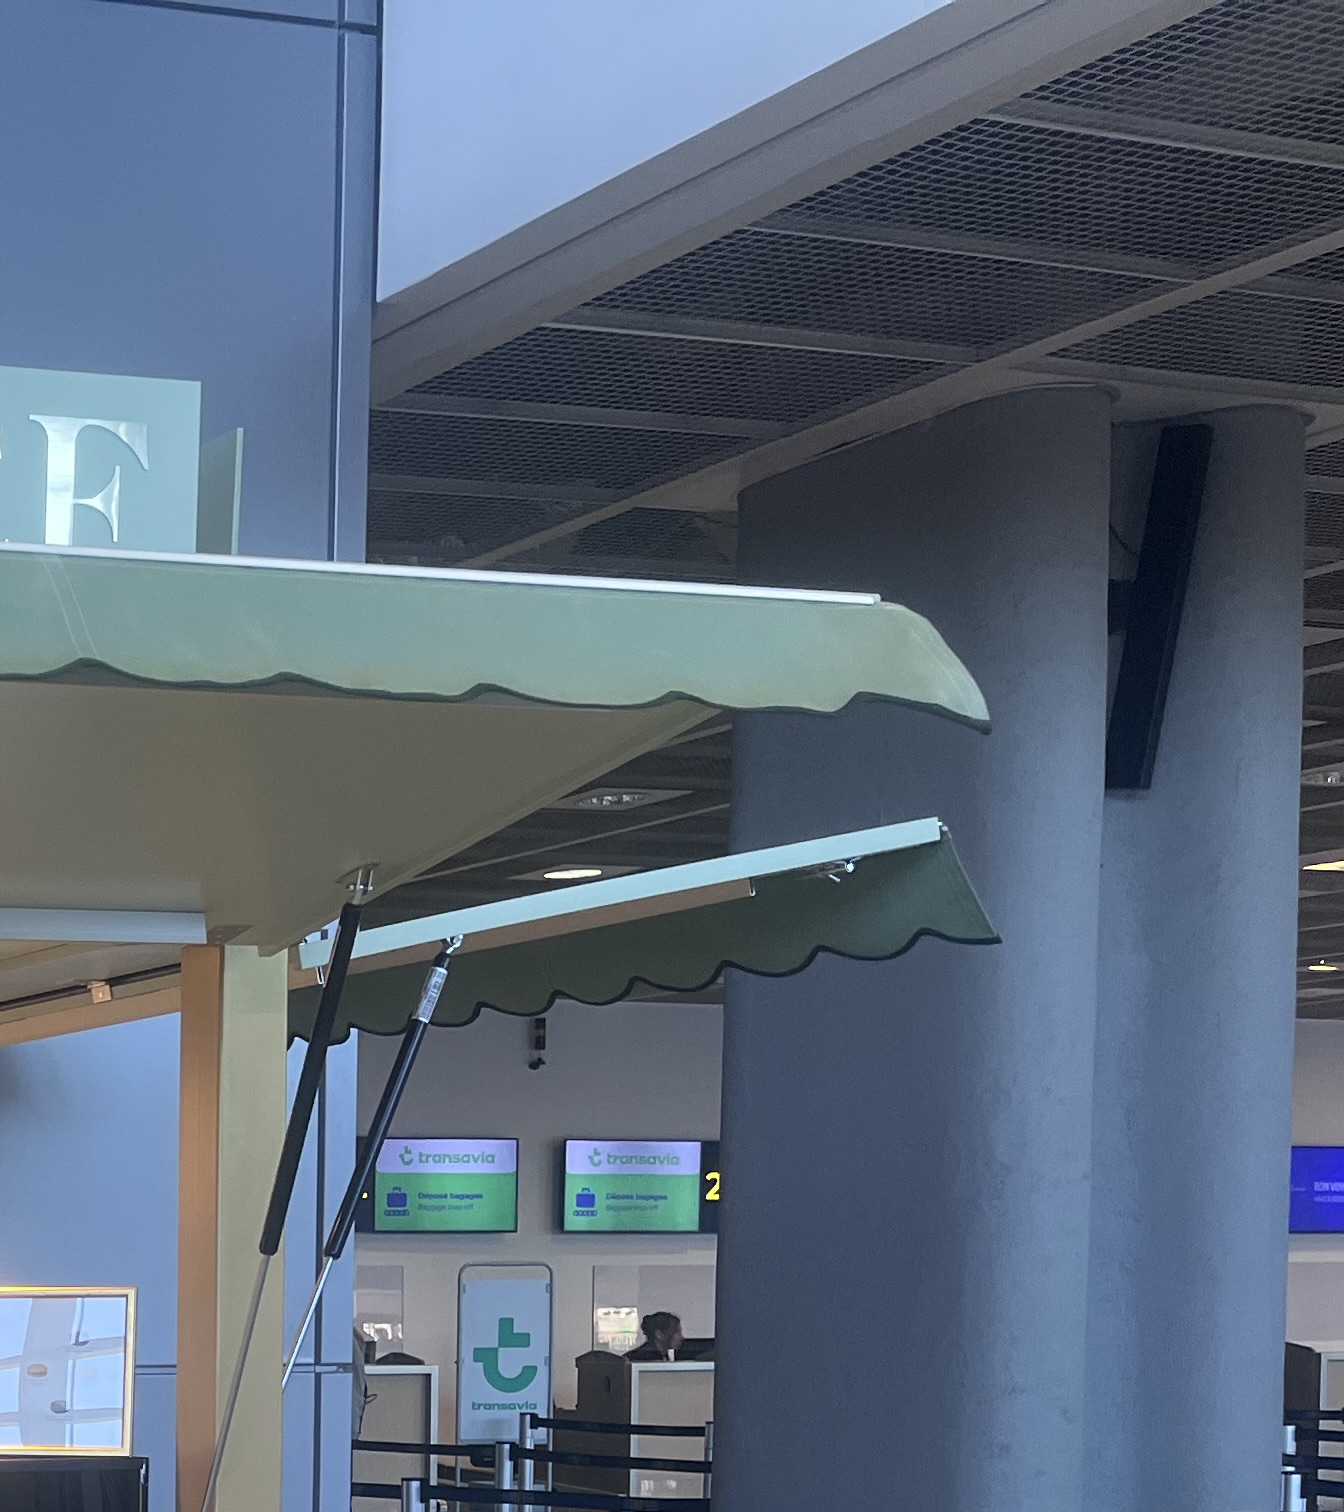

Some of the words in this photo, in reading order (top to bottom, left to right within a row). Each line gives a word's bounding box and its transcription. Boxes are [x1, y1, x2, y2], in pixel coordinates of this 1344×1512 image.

[418, 1151, 495, 1164] transavia
[607, 1152, 681, 1165] transavia
[471, 1400, 538, 1411] transavia
